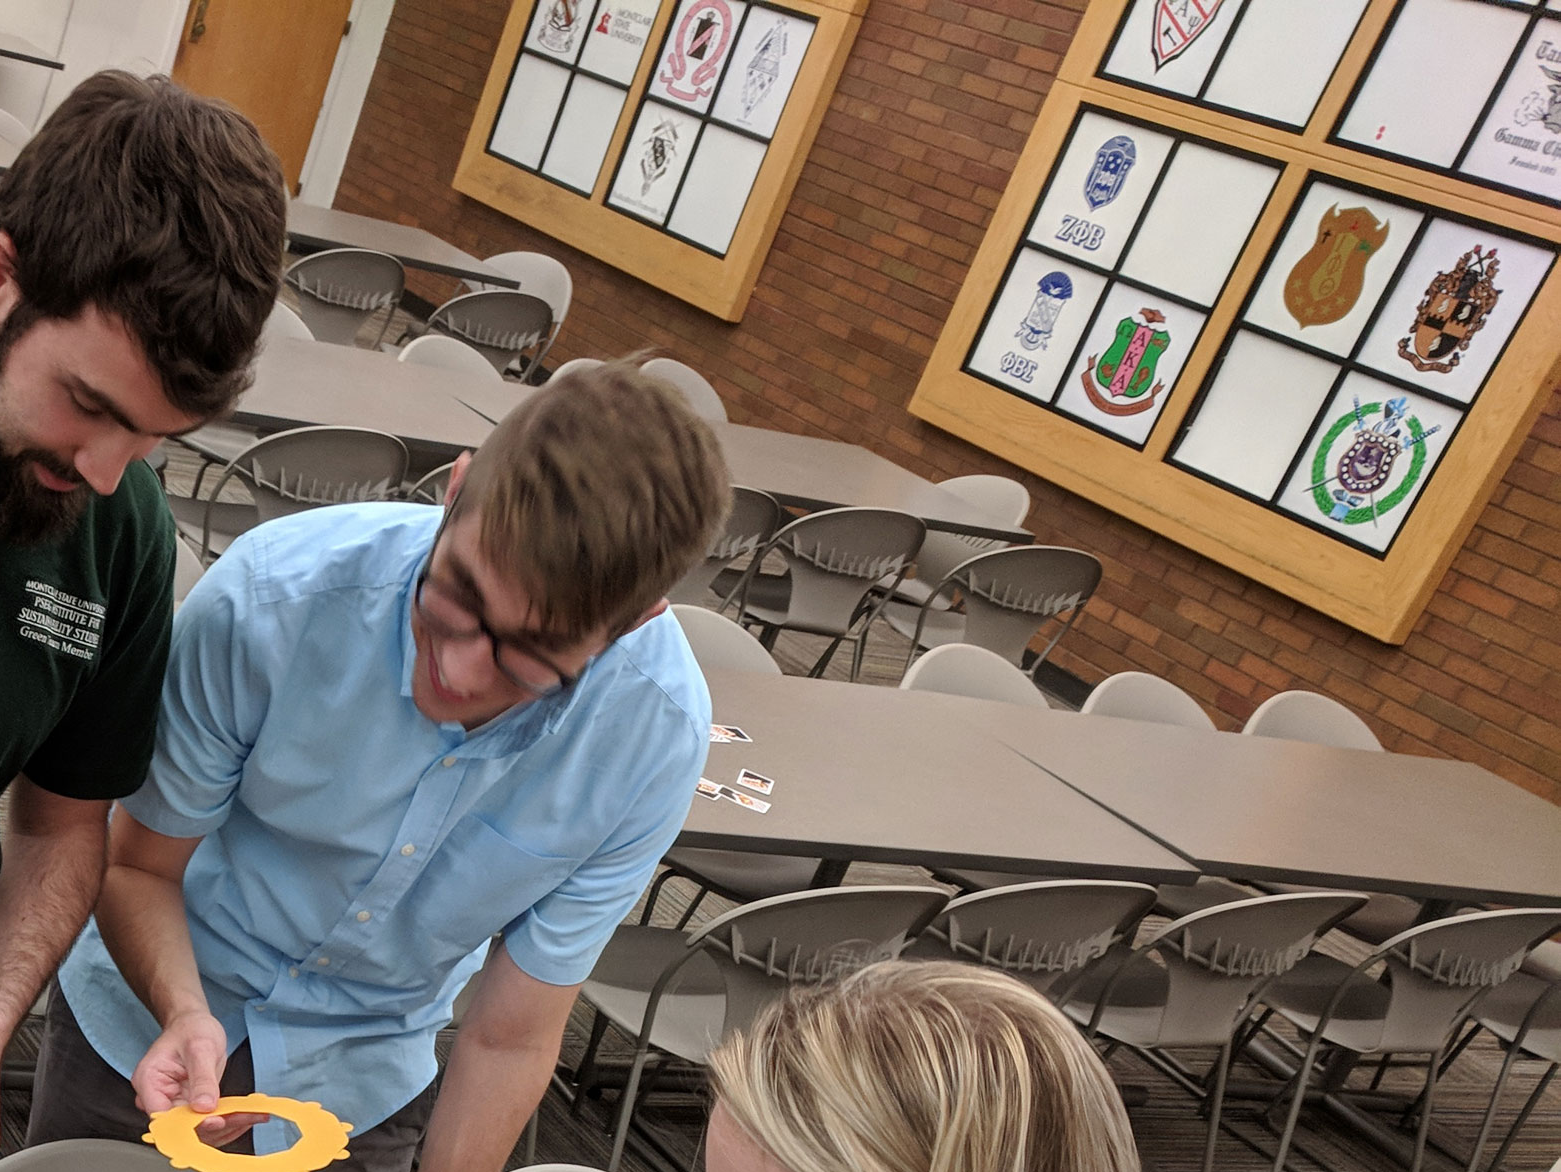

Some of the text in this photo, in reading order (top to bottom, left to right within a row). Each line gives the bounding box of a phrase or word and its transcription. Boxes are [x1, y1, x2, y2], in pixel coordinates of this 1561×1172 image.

[1494, 127, 1541, 152] Gamma
[58, 590, 78, 606] STATE
[20, 625, 48, 643] Green
